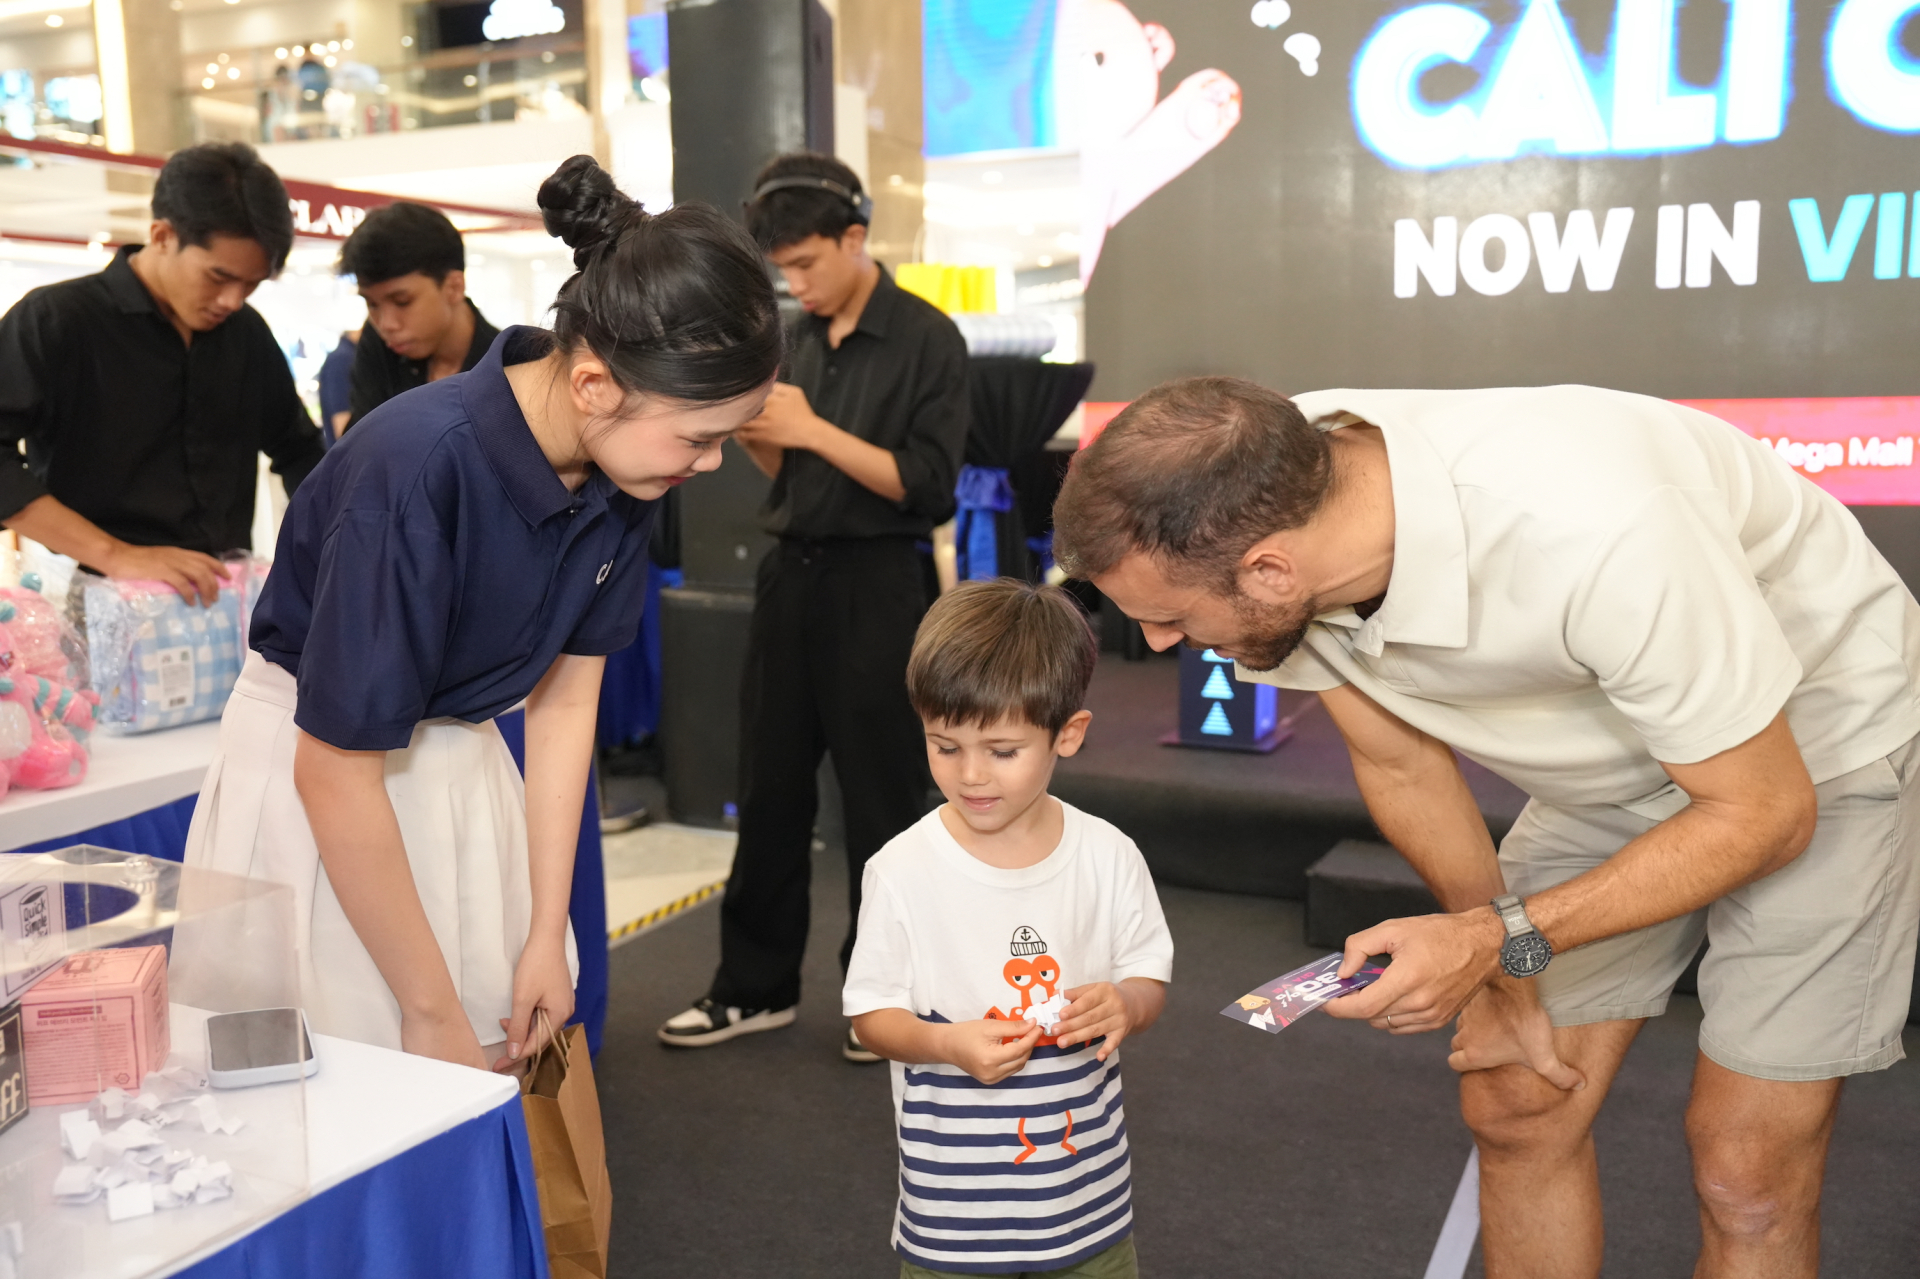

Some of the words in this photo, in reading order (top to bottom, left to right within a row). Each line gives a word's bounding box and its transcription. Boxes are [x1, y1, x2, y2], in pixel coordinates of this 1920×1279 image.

[1352, 0, 1788, 168] CALI
[1394, 206, 1635, 299] NOW
[1655, 199, 1761, 289] IN
[1788, 190, 1920, 283] VI
[1848, 436, 1914, 467] Mall
[23, 897, 47, 922] Quick
